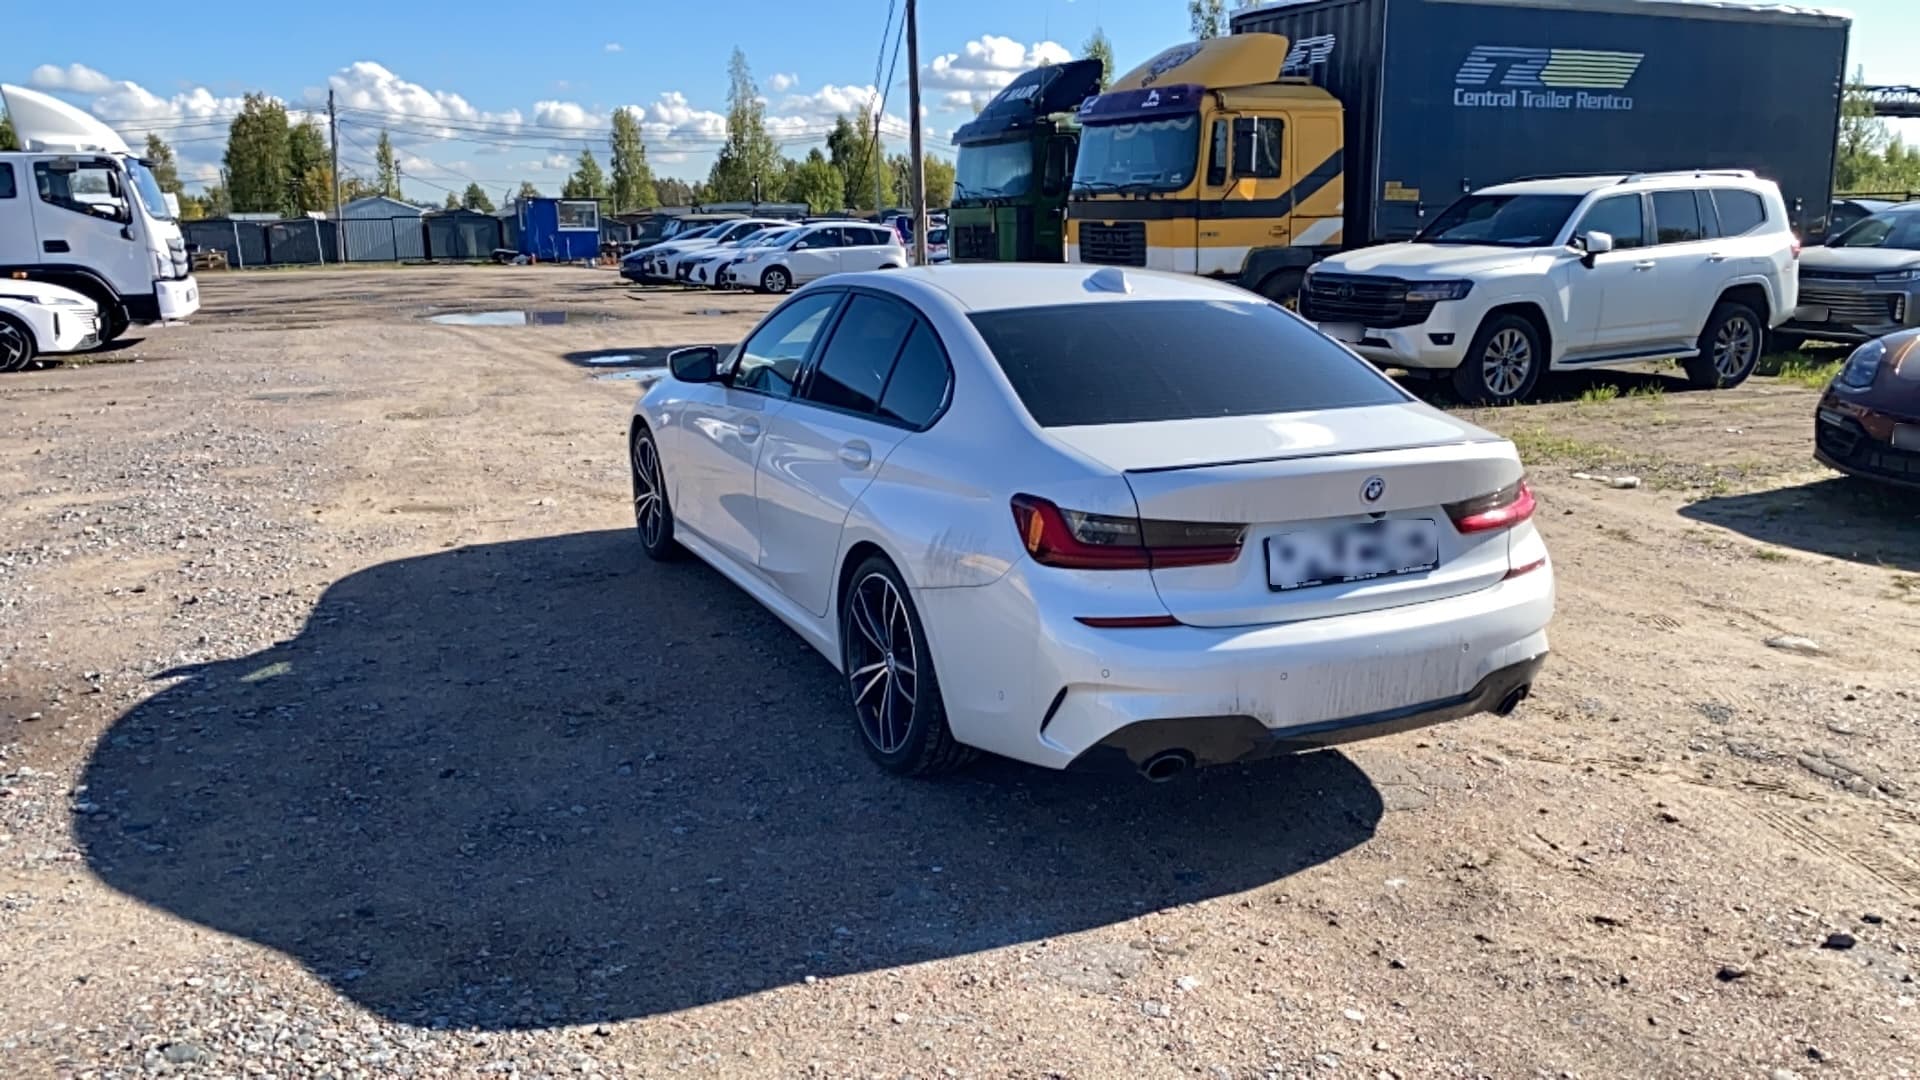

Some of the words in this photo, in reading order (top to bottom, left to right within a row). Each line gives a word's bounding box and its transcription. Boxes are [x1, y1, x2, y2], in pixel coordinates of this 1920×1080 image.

[1453, 88, 1517, 107] Central
[1519, 90, 1573, 109] Trailer
[1576, 91, 1633, 110] Rentco
